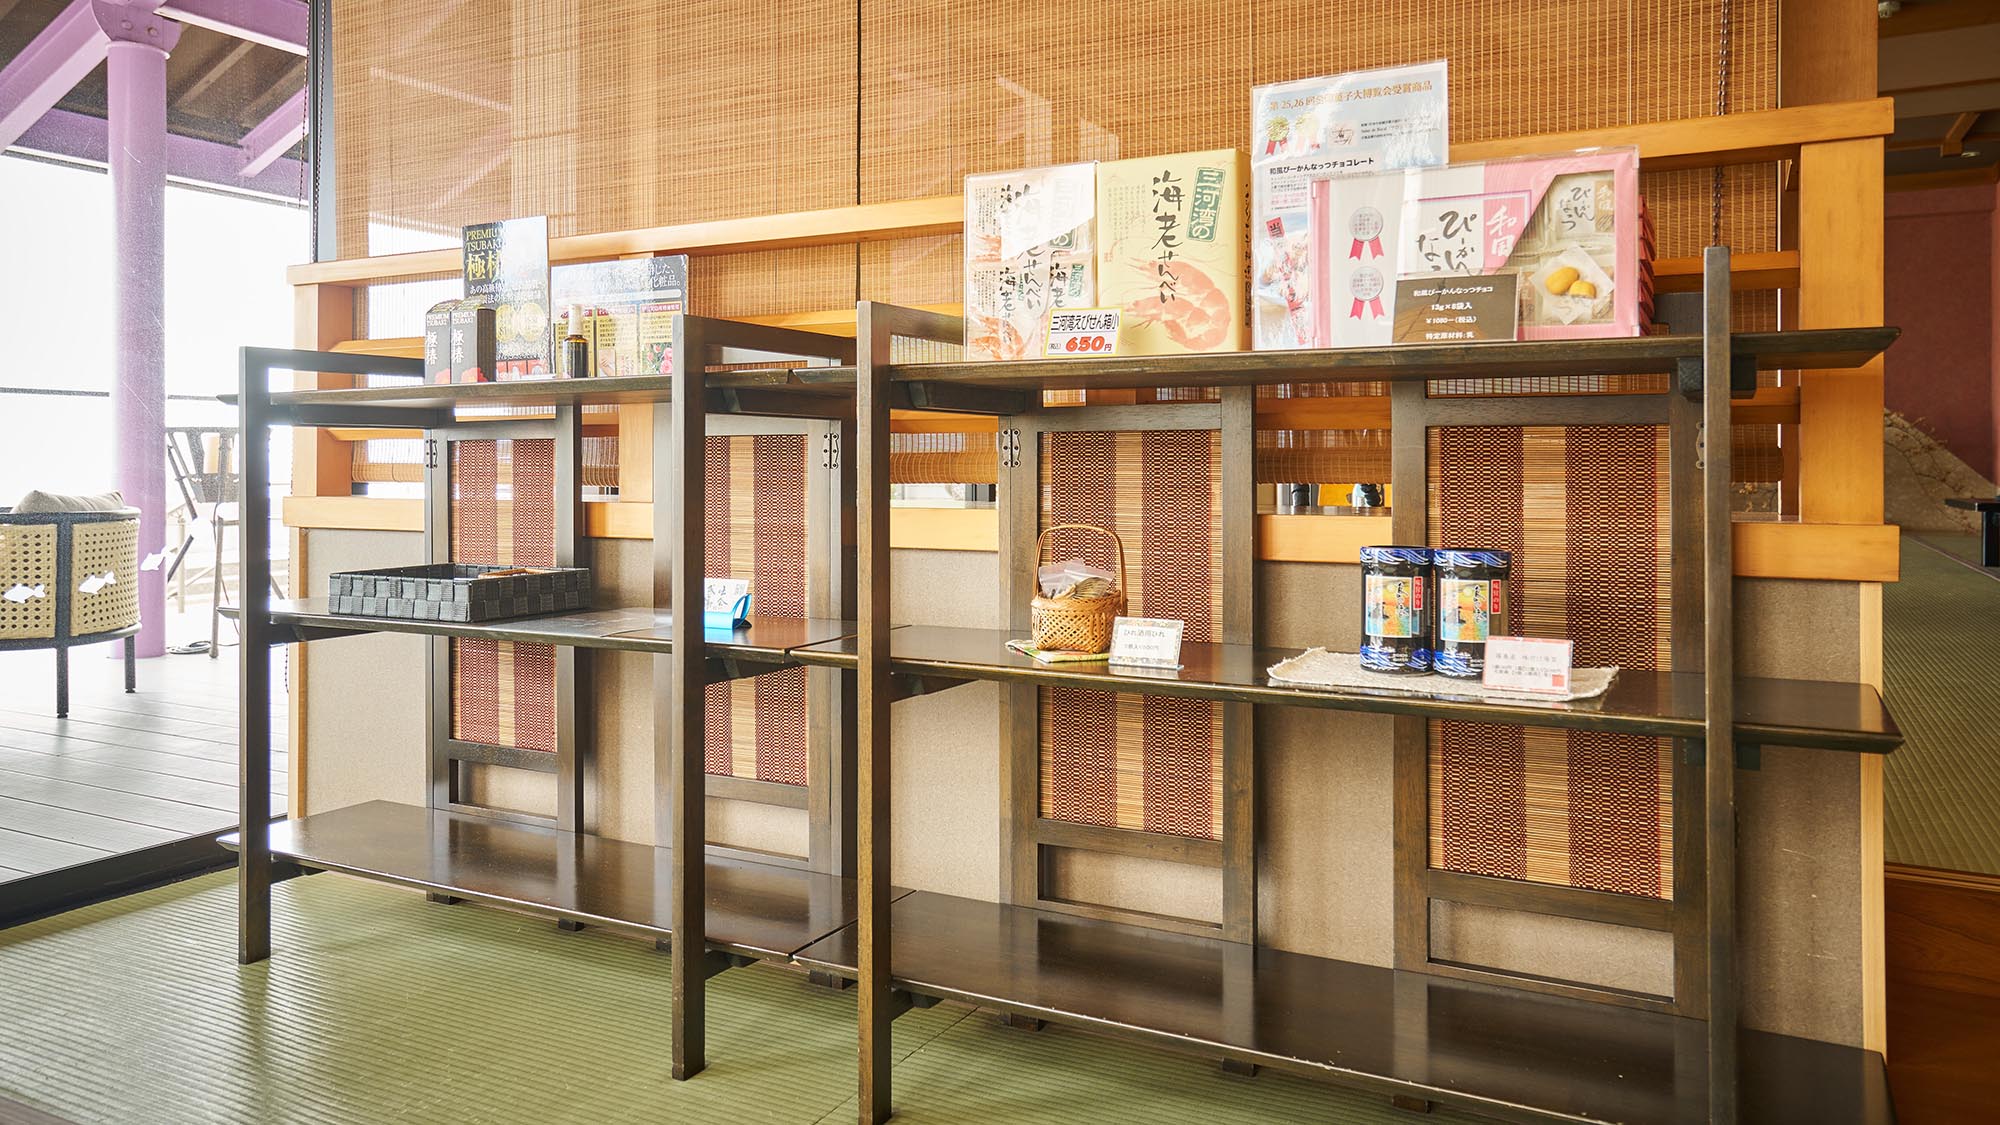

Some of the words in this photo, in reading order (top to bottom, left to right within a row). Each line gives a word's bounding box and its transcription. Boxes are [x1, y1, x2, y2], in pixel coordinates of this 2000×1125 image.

[1150, 169, 1187, 305] 海老せんべい
[1191, 169, 1224, 239] 三河湾の
